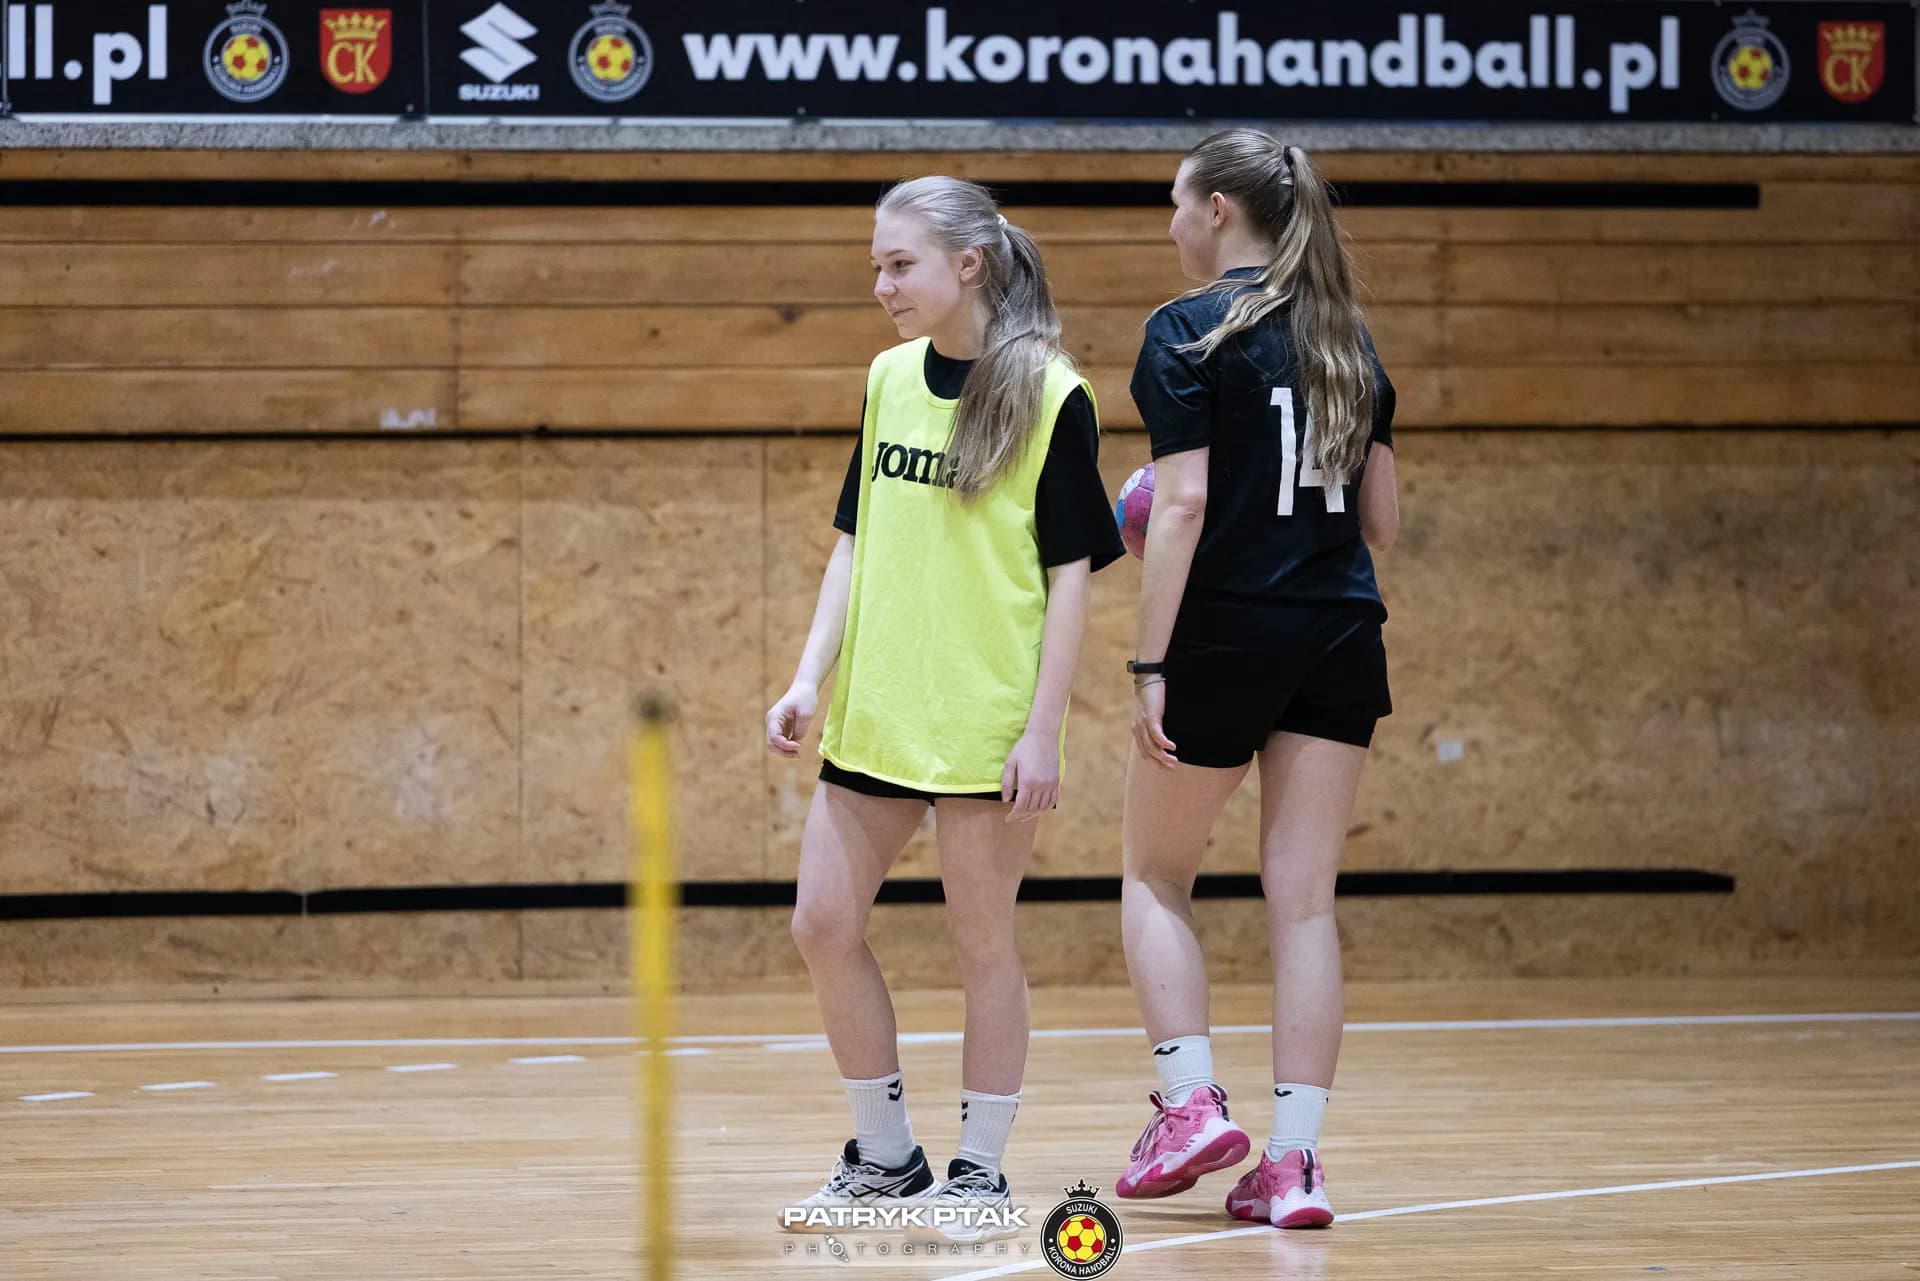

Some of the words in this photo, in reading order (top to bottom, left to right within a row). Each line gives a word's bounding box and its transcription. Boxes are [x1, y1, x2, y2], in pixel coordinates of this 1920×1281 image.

[326, 42, 378, 84] CK
[682, 8, 1680, 112] www.koronahandball.pl
[1824, 54, 1872, 94] CK
[458, 83, 540, 101] SUZUKI
[1270, 387, 1350, 515] 14
